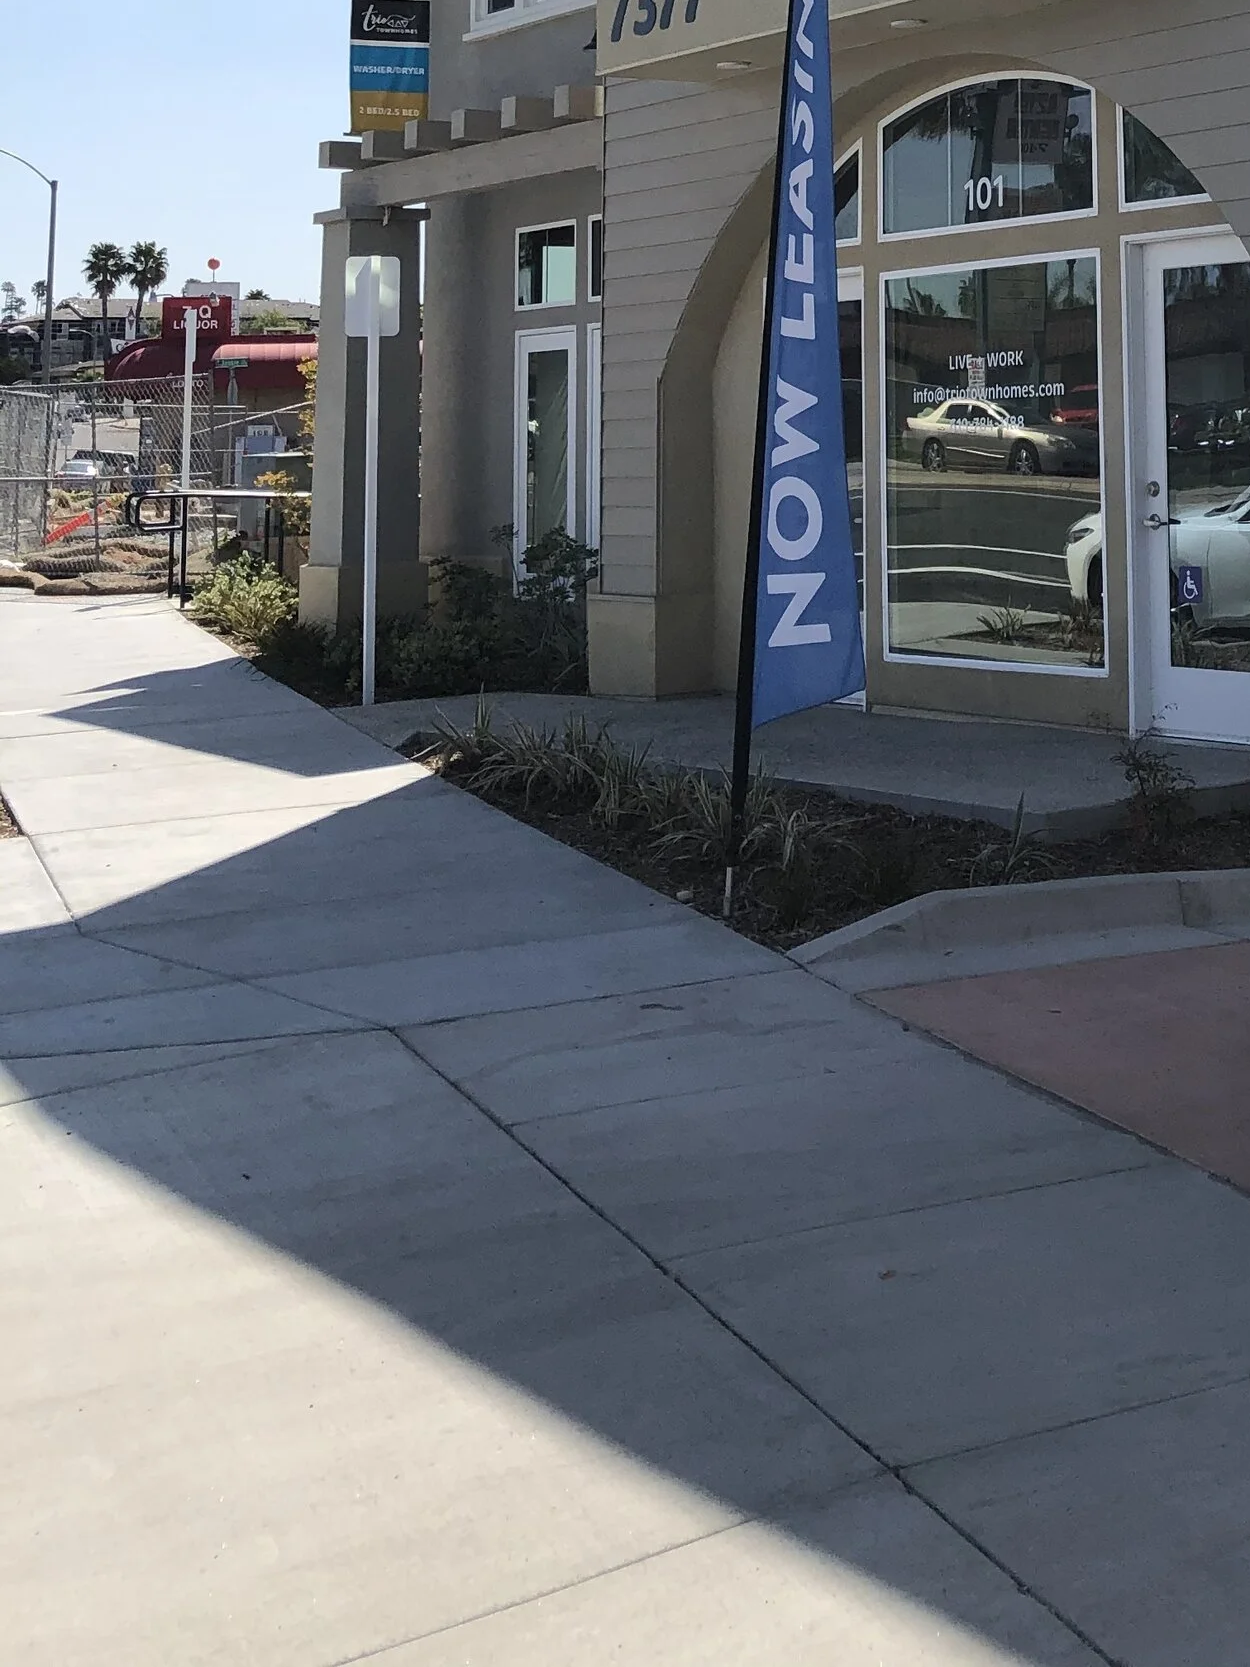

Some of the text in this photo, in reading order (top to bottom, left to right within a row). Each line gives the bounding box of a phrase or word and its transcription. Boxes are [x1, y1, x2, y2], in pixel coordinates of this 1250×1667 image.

[362, 4, 388, 31] trio
[353, 65, 425, 75] WASHER/DRYER
[359, 106, 365, 114] 2
[963, 174, 1004, 211] 101
[182, 305, 212, 319] 7Q
[173, 320, 218, 330] LIUOR
[949, 350, 1024, 370] LIVE WORK
[172, 379, 204, 389] LOTO
[913, 382, 1065, 404] info@triotownhomes.com
[767, 374, 832, 648] NOW
